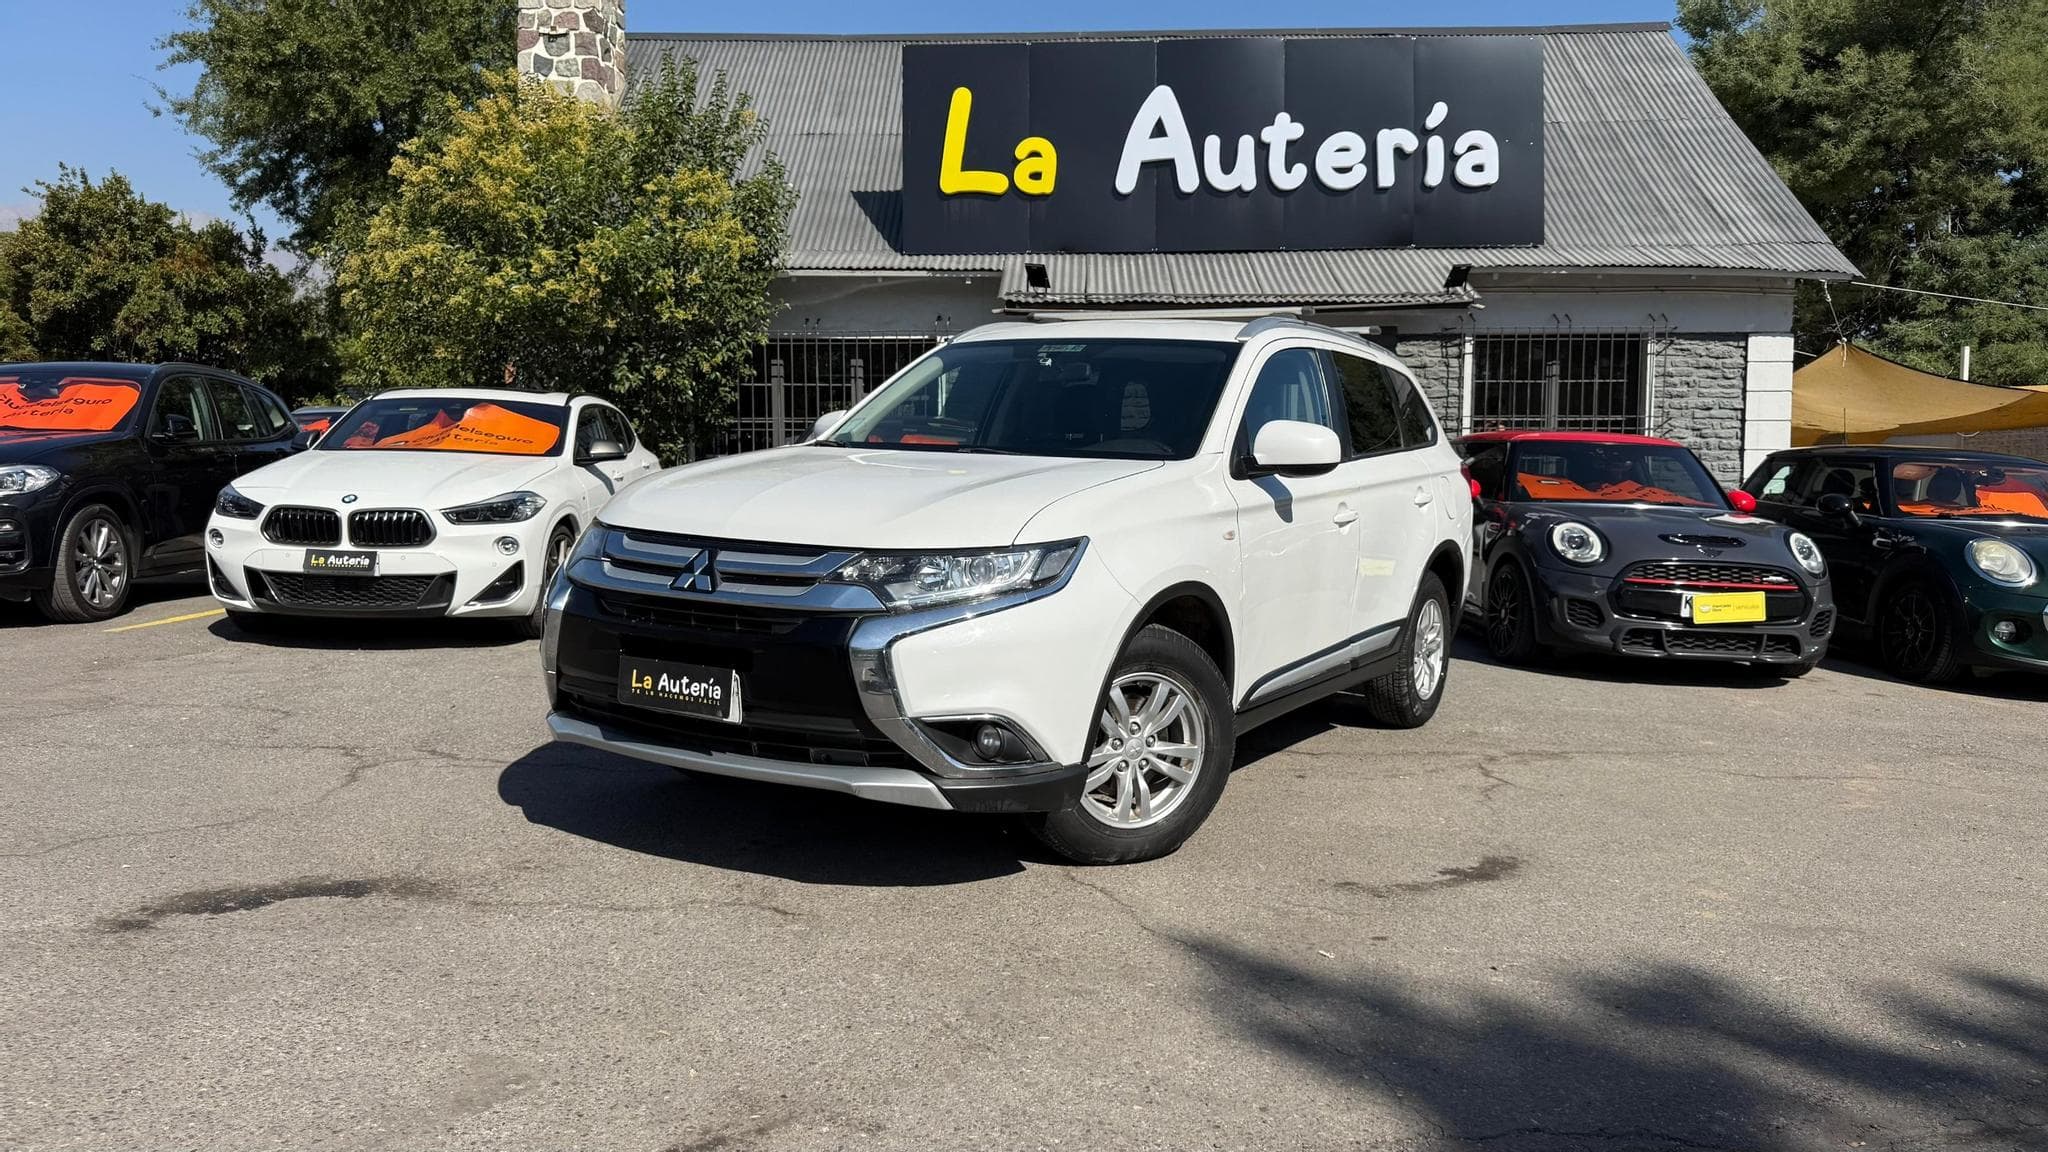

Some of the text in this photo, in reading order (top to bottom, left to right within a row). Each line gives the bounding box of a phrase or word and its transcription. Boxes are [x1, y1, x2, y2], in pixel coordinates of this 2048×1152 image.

[940, 84, 1500, 195] La Autería
[311, 554, 370, 565] La Autería
[631, 669, 721, 699] La Autería
